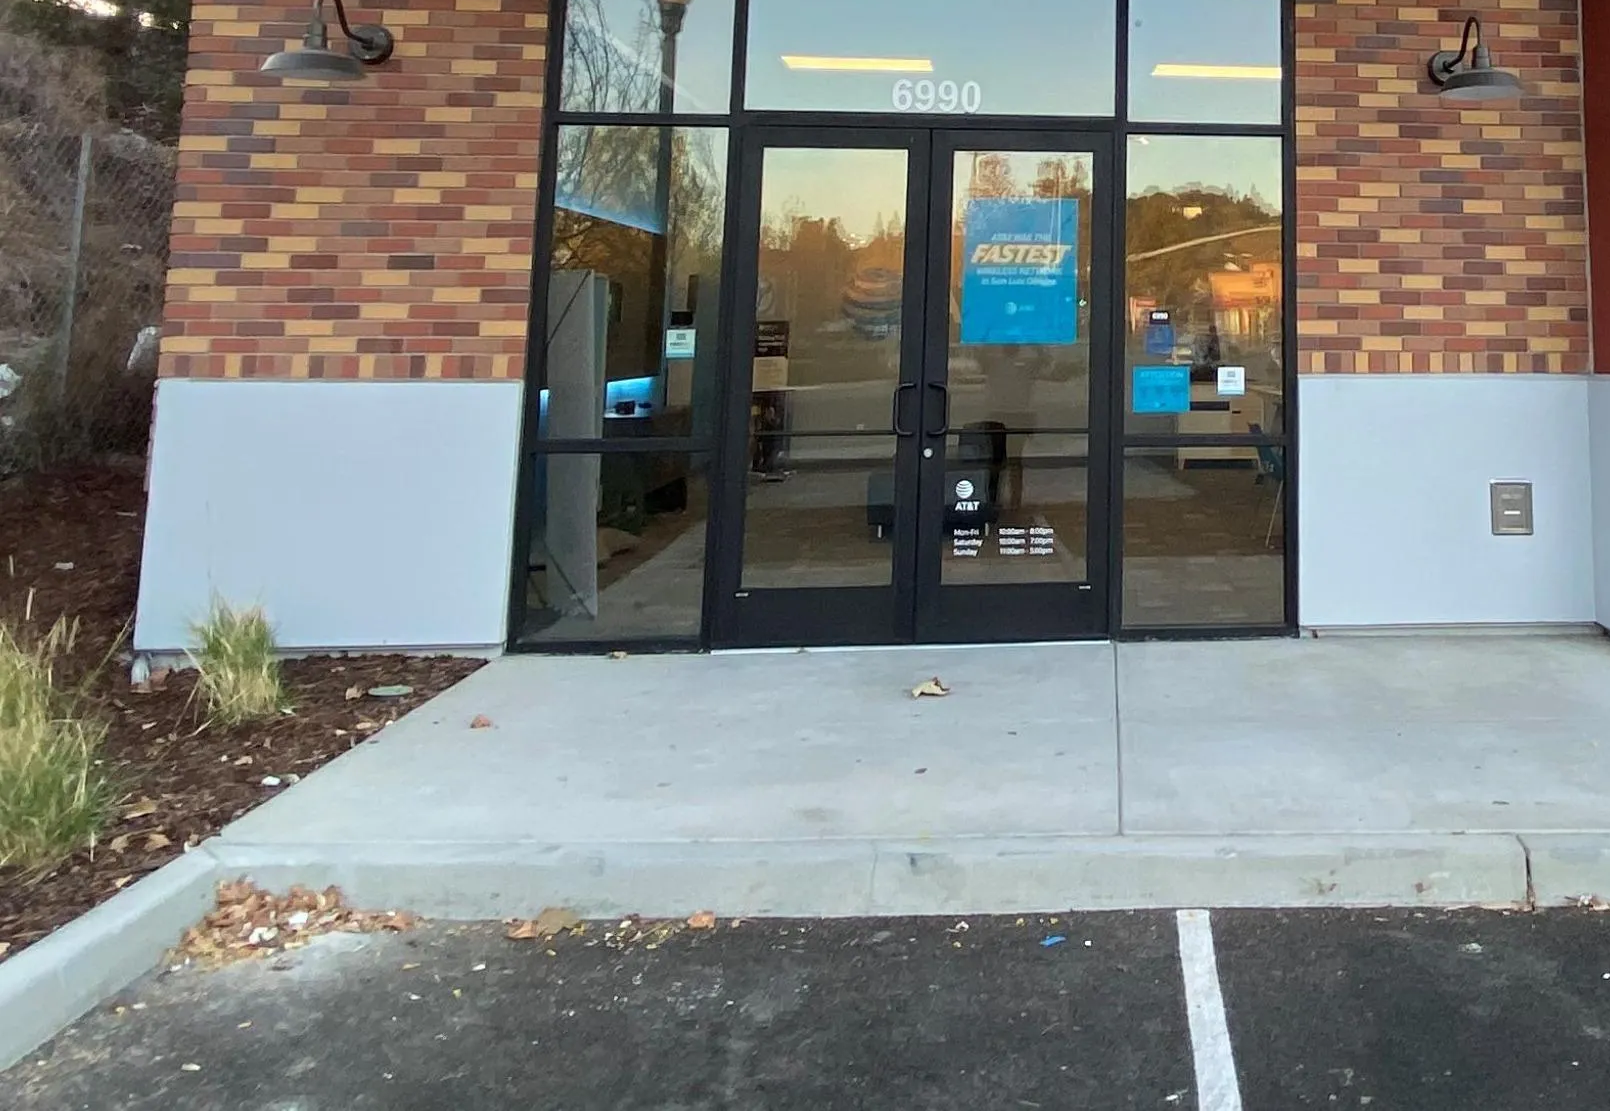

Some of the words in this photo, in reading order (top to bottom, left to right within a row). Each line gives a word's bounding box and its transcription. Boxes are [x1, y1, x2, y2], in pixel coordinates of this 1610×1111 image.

[892, 78, 981, 114] 6990
[971, 244, 1073, 265] FASTEST
[955, 501, 980, 511] AT&T
[953, 539, 983, 547] Saturday
[953, 548, 978, 557] Sunday
